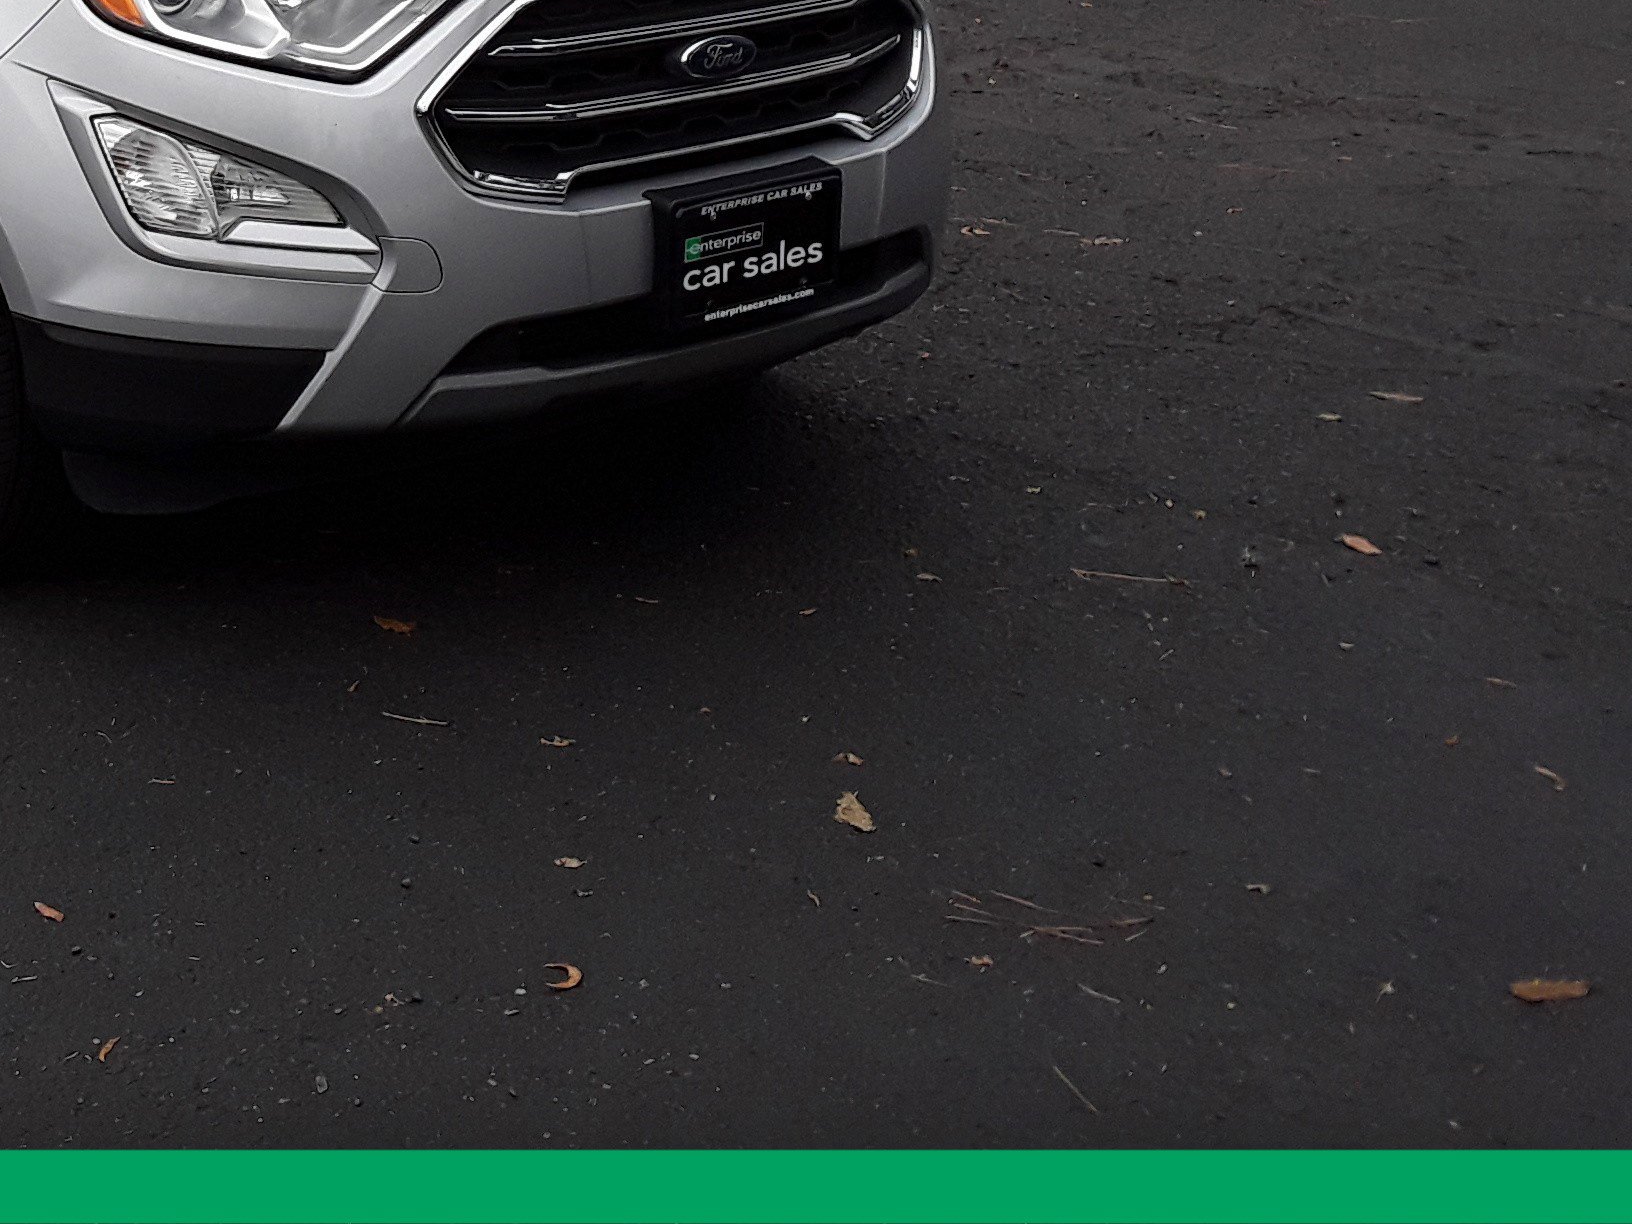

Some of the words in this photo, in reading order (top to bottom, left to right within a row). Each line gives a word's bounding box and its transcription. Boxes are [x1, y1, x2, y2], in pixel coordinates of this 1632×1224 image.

[704, 43, 743, 69] Ford
[700, 194, 765, 216] ENTERPRISE
[766, 189, 788, 201] CAR
[789, 182, 823, 197] SALES
[687, 230, 762, 256] enterprise
[683, 259, 735, 292] car
[742, 240, 824, 279] sales
[704, 288, 815, 322] enterprisecarsales.com
